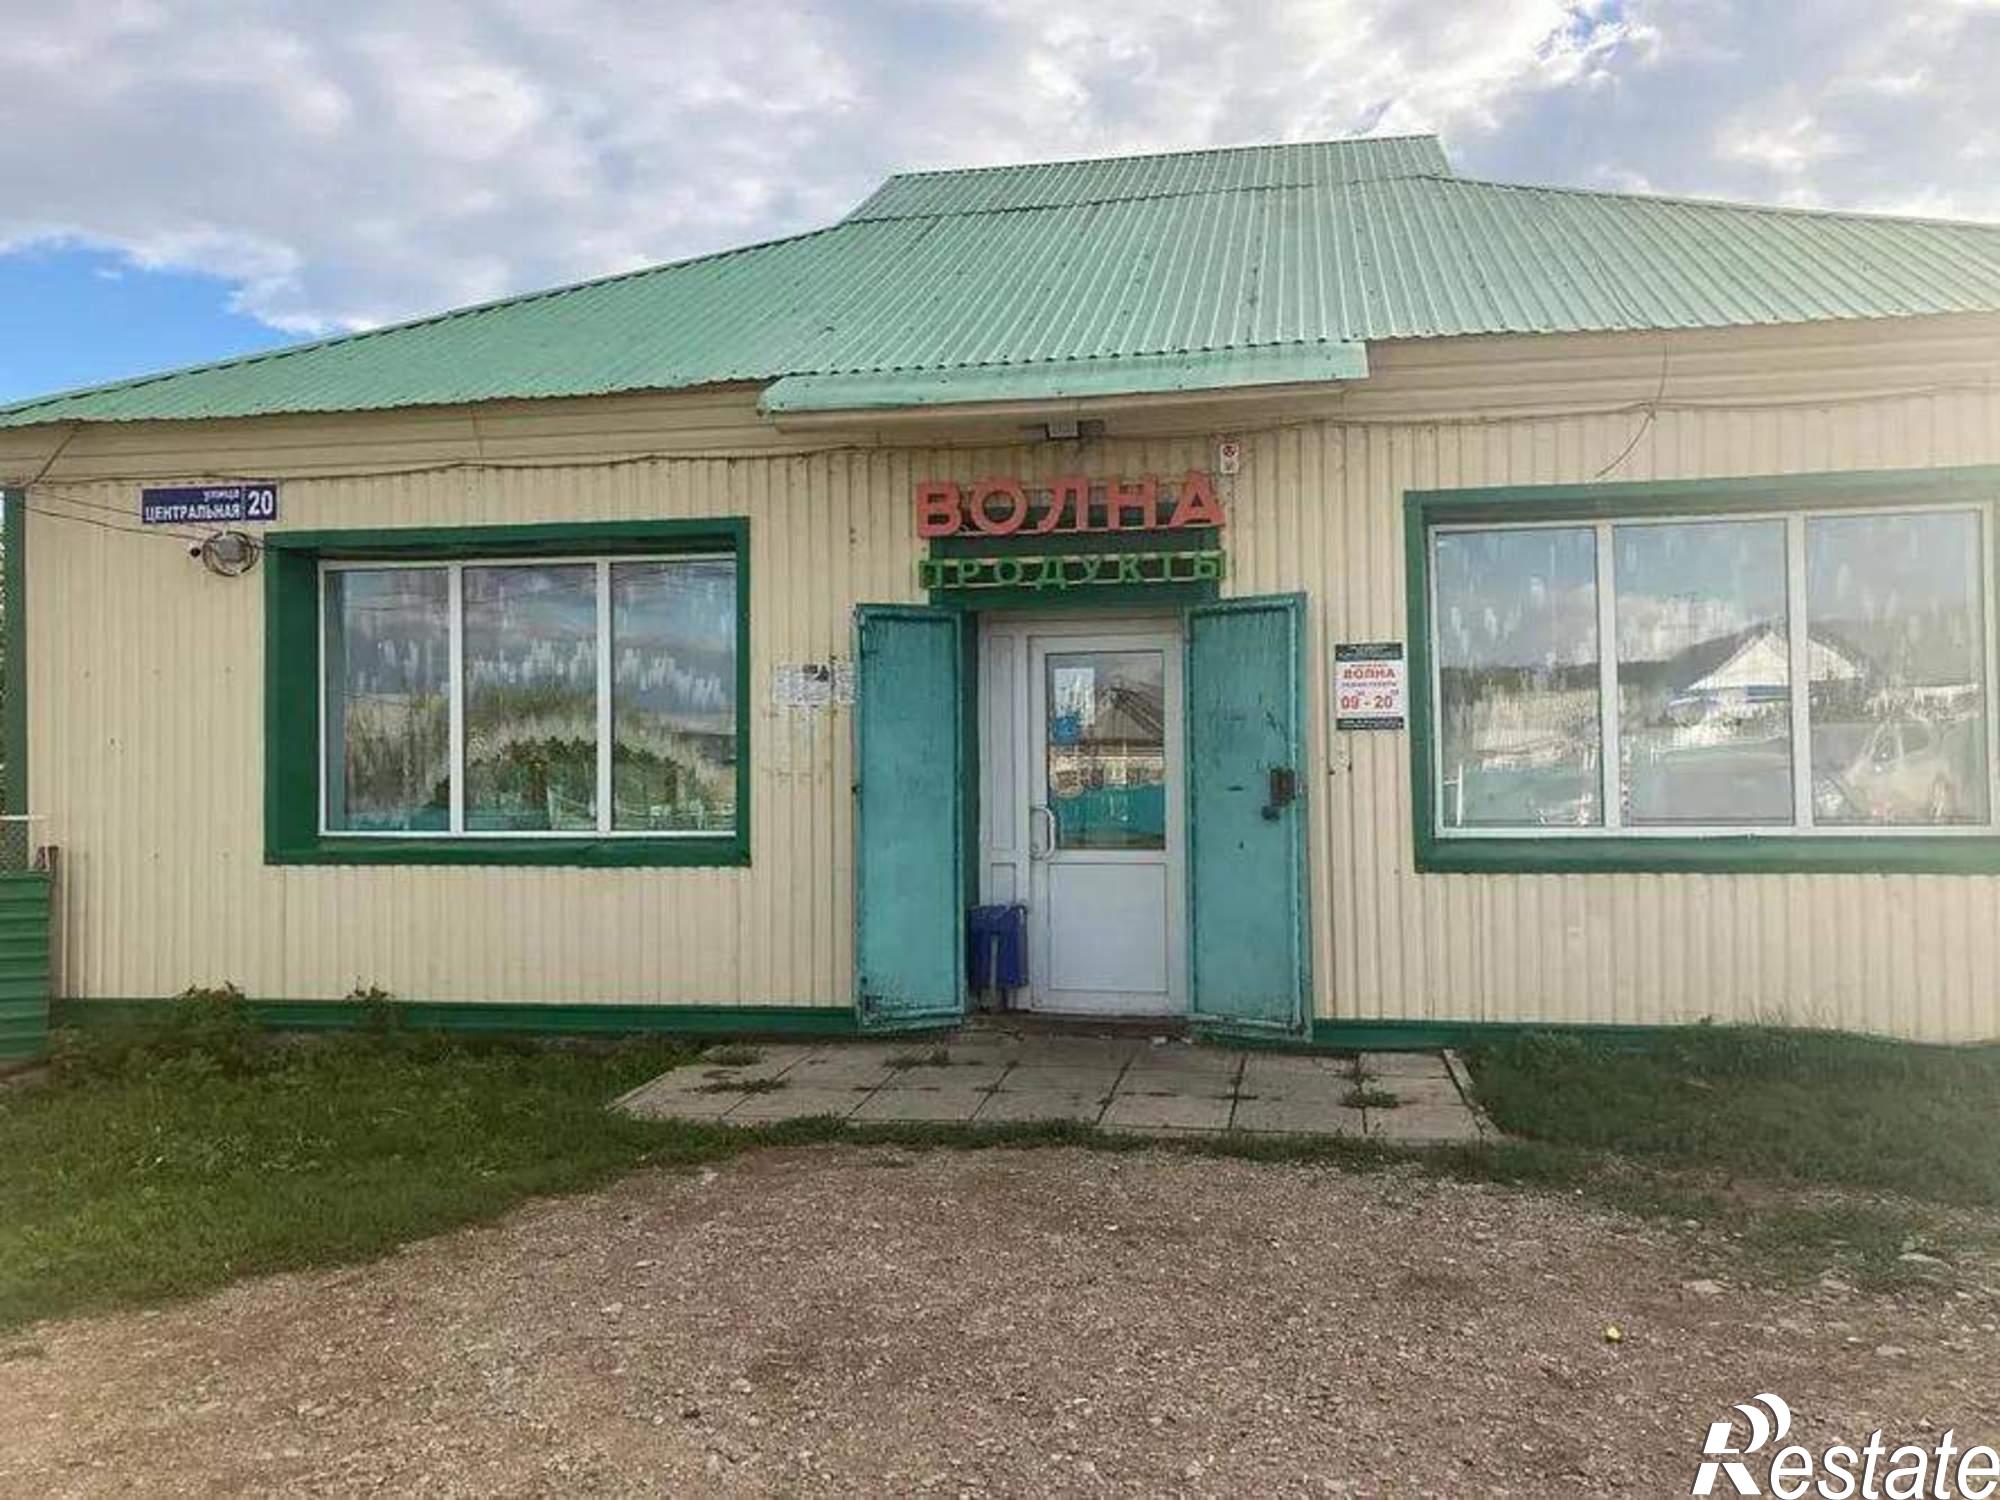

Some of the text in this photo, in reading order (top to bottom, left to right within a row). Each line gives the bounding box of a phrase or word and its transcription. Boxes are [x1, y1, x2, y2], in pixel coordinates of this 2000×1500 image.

[145, 503, 241, 522] ЦЕНТРАЛЬНАЯ
[247, 490, 274, 515] 20
[915, 471, 1226, 539] ВОЛНА
[919, 552, 1225, 590] ПРОДУКТЫ
